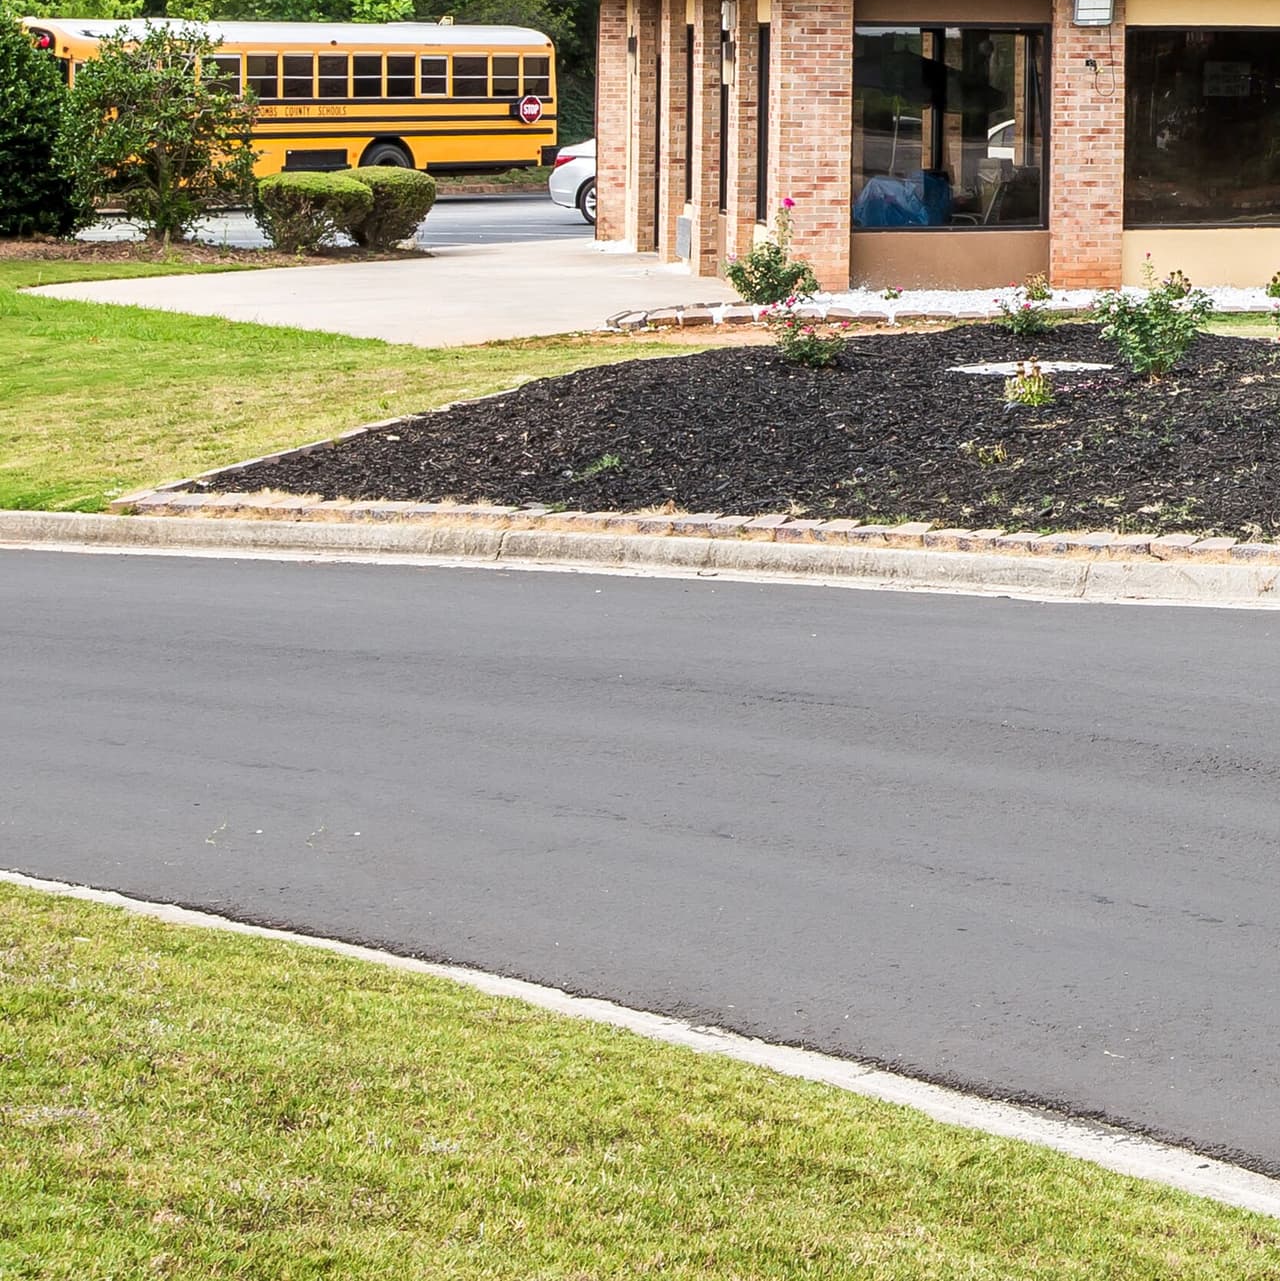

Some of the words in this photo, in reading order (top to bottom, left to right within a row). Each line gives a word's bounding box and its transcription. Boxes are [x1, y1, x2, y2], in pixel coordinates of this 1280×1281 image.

[285, 106, 311, 117] COUNTY
[318, 106, 347, 116] SCHOOLS
[523, 104, 539, 115] STOP
